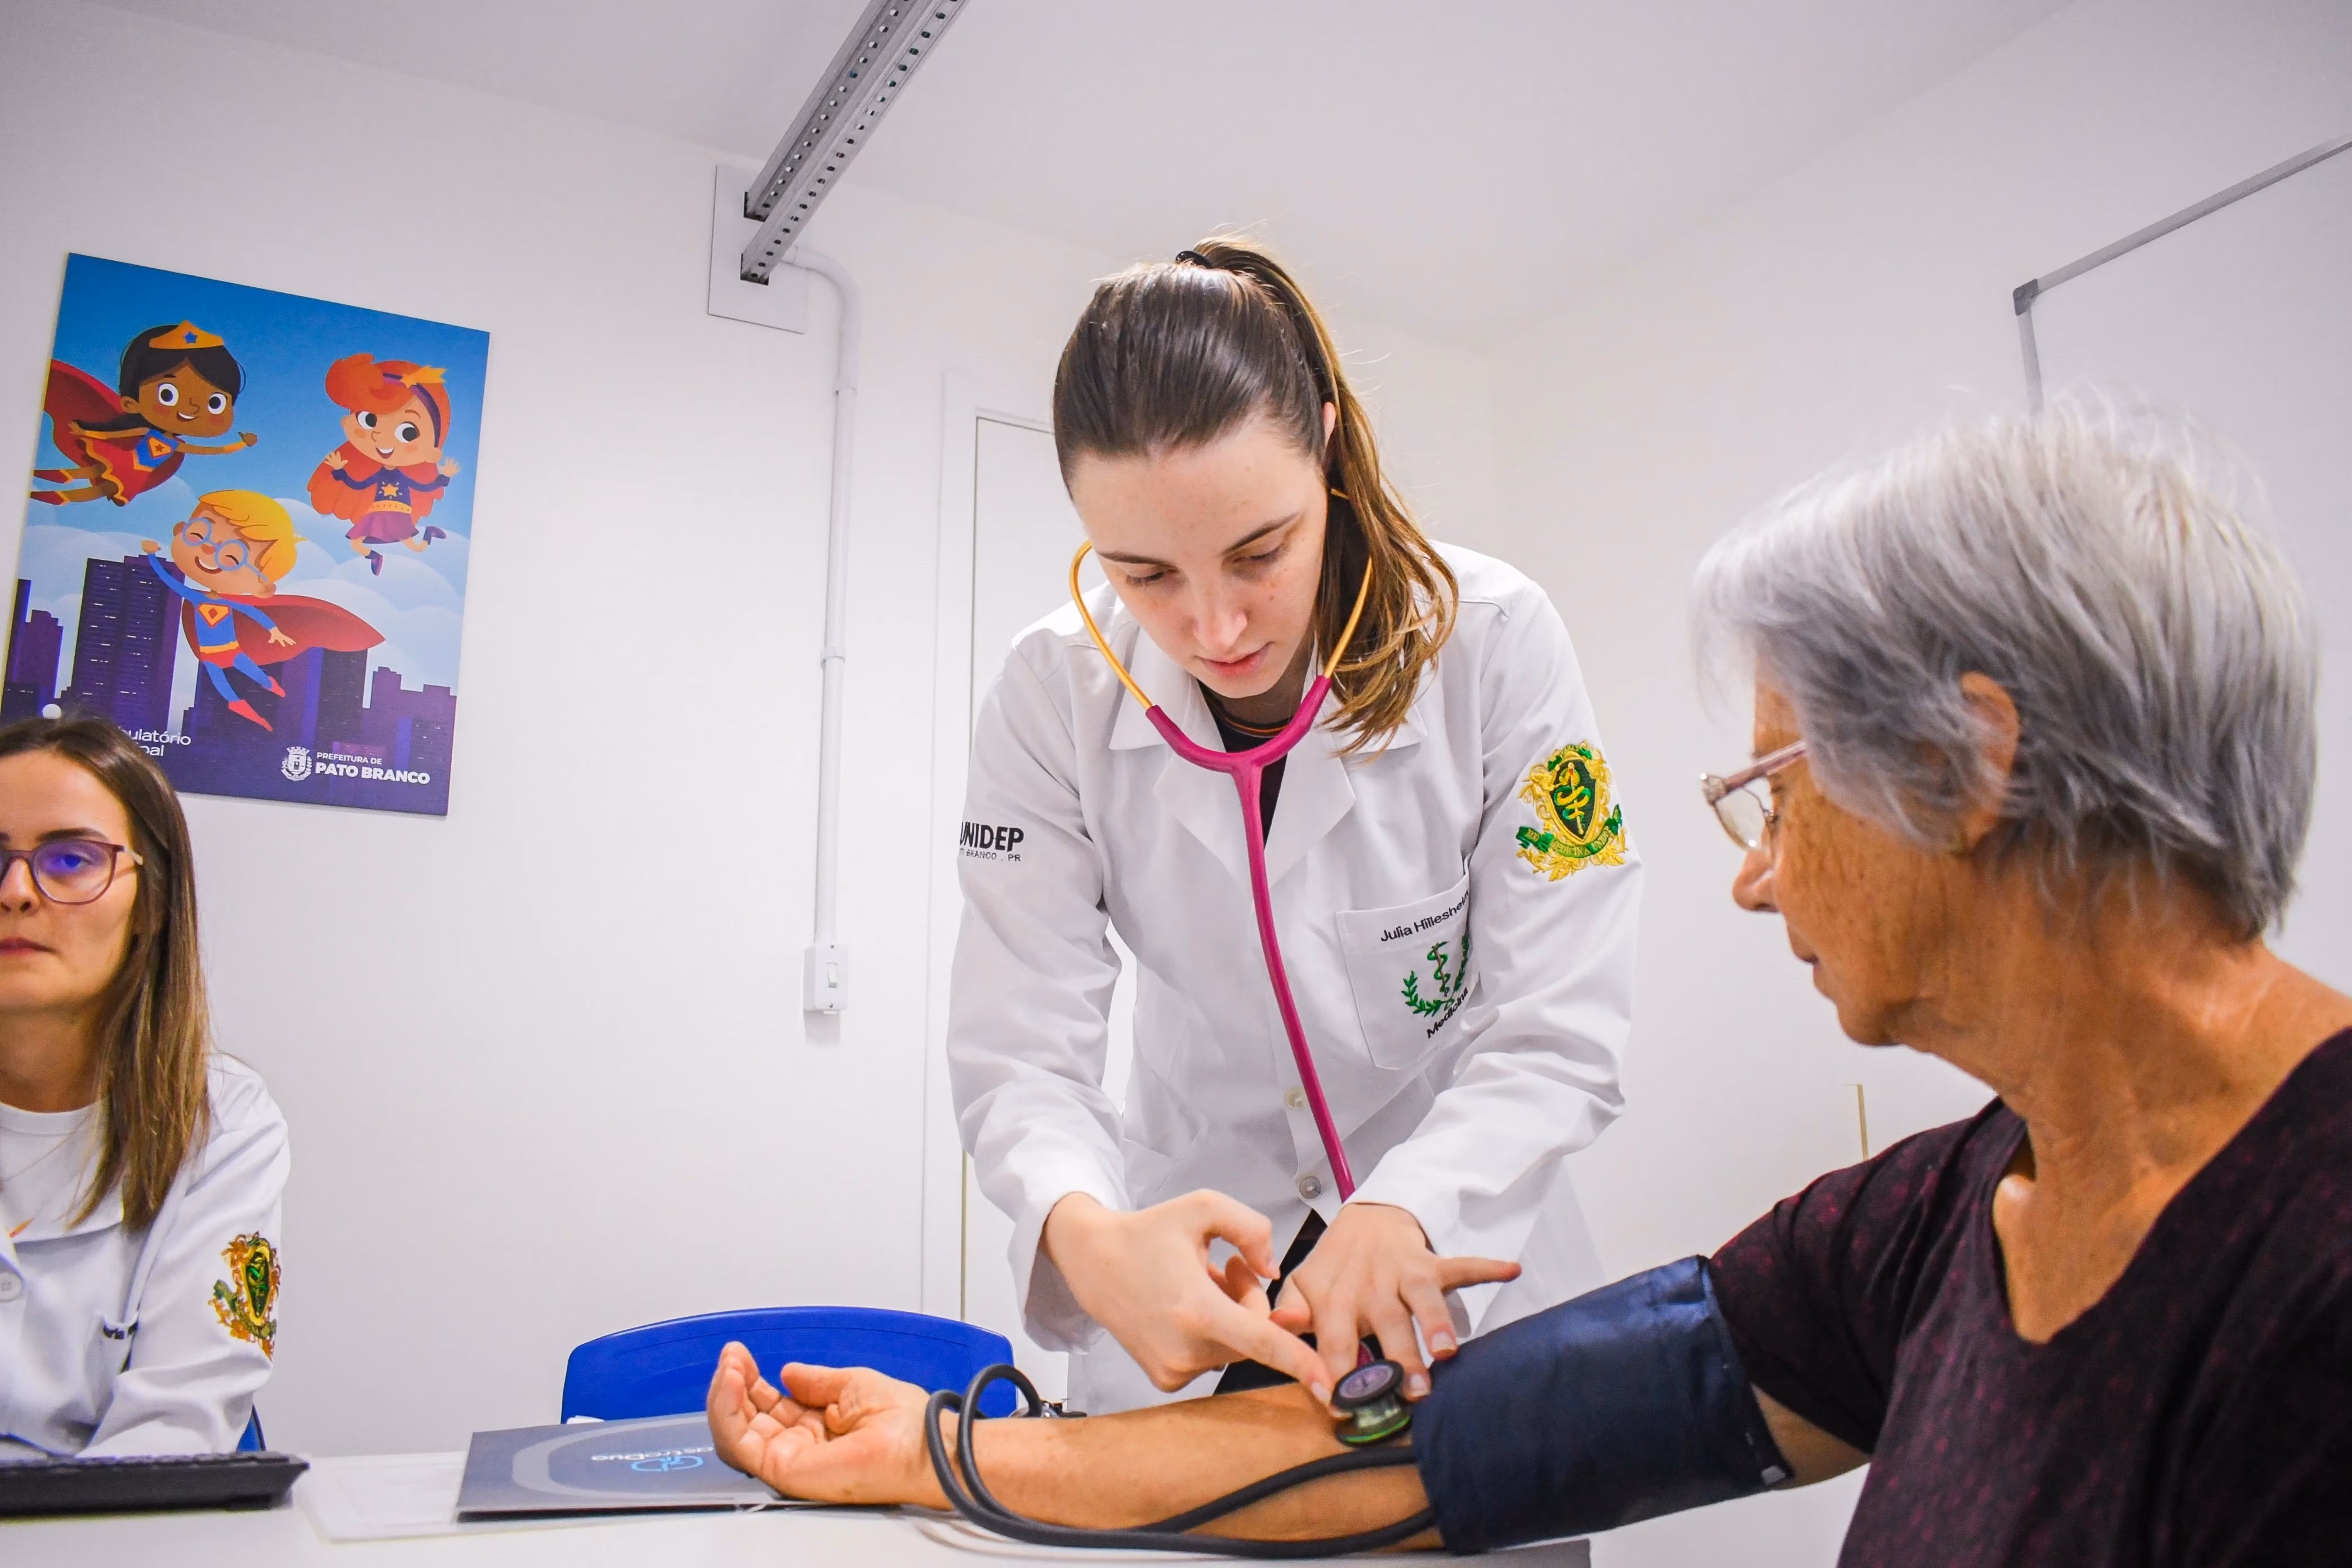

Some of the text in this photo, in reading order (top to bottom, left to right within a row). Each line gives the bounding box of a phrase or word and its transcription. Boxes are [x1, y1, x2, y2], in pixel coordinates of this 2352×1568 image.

[118, 726, 191, 746] ulatório
[317, 752, 382, 765] PREFEITURA DE
[315, 762, 430, 785] PATO BRANCO
[966, 849, 997, 860] BRANCO
[1380, 926, 1413, 942] Julia
